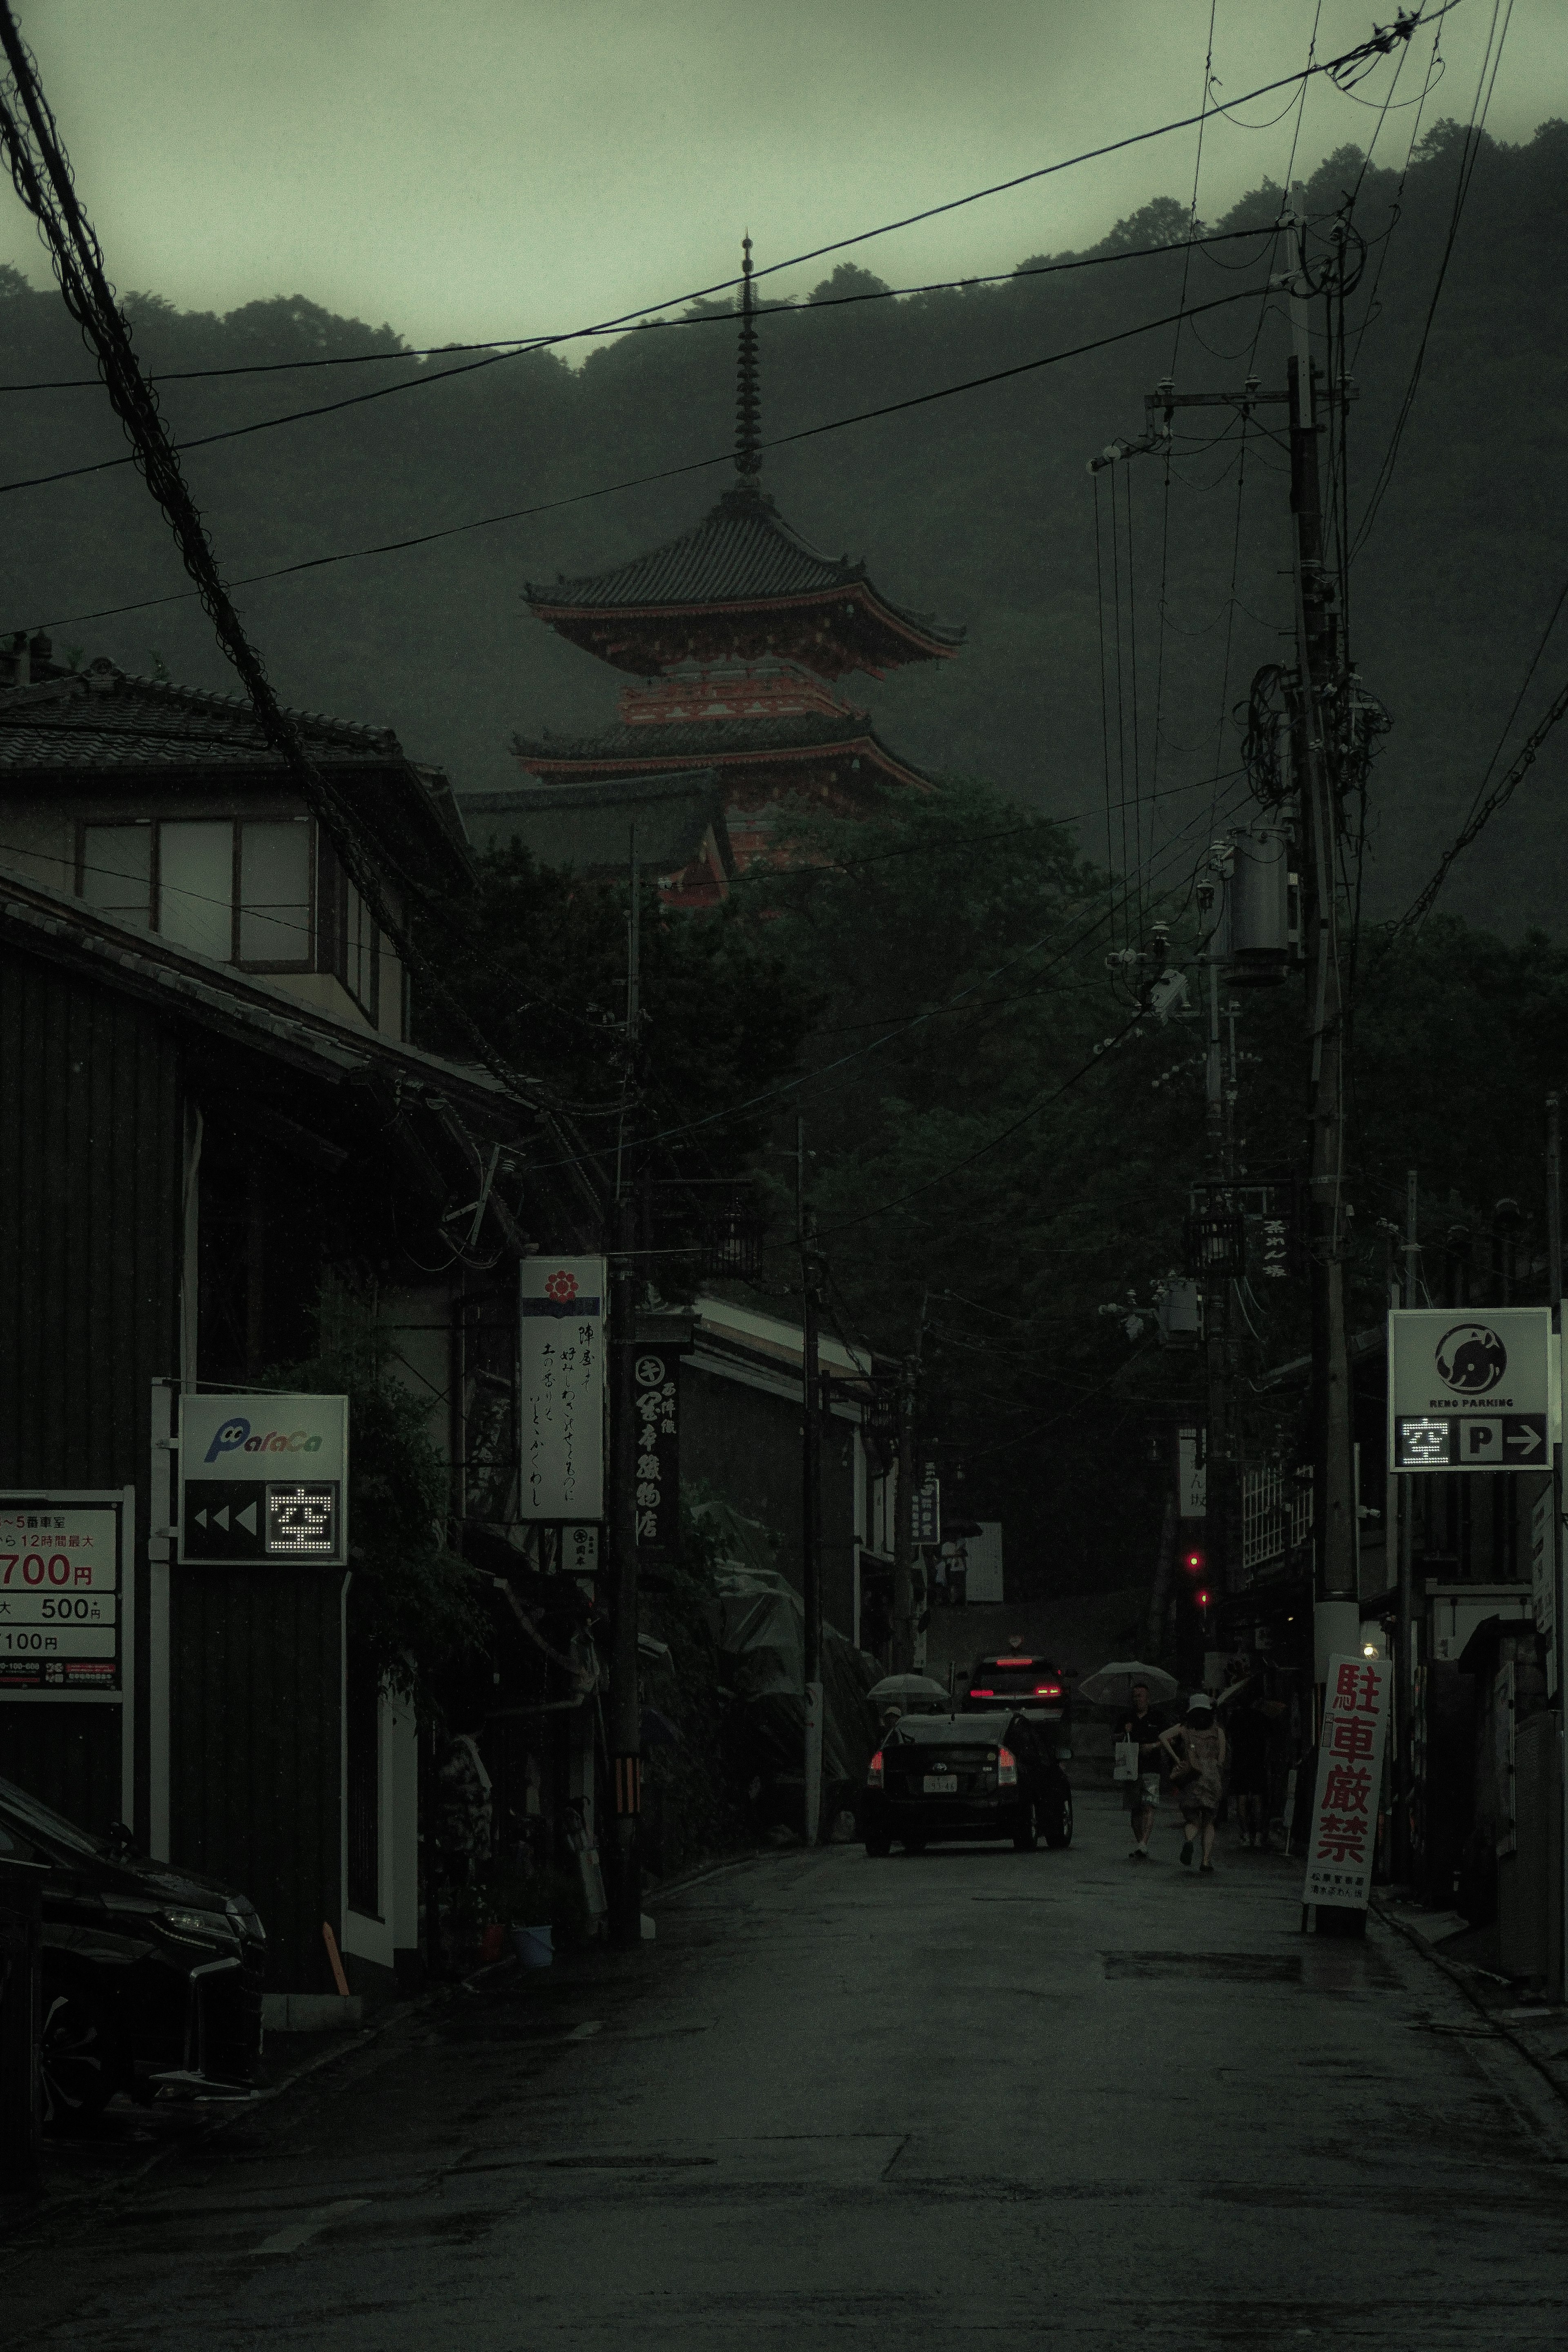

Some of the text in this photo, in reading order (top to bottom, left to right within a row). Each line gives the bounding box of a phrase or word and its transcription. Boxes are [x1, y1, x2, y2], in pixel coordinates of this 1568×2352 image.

[1430, 1399, 1514, 1408] RENO PARKING
[1402, 1418, 1449, 1465] 空
[1470, 1426, 1492, 1454] P
[0, 1515, 66, 1529] ～5番車室
[270, 1488, 332, 1549] 空
[0, 1535, 94, 1548] ら 12時間最大
[42, 1598, 100, 1619] 500円
[0, 1633, 57, 1650] 100円
[1316, 1662, 1381, 1864] 駐車厳禁
